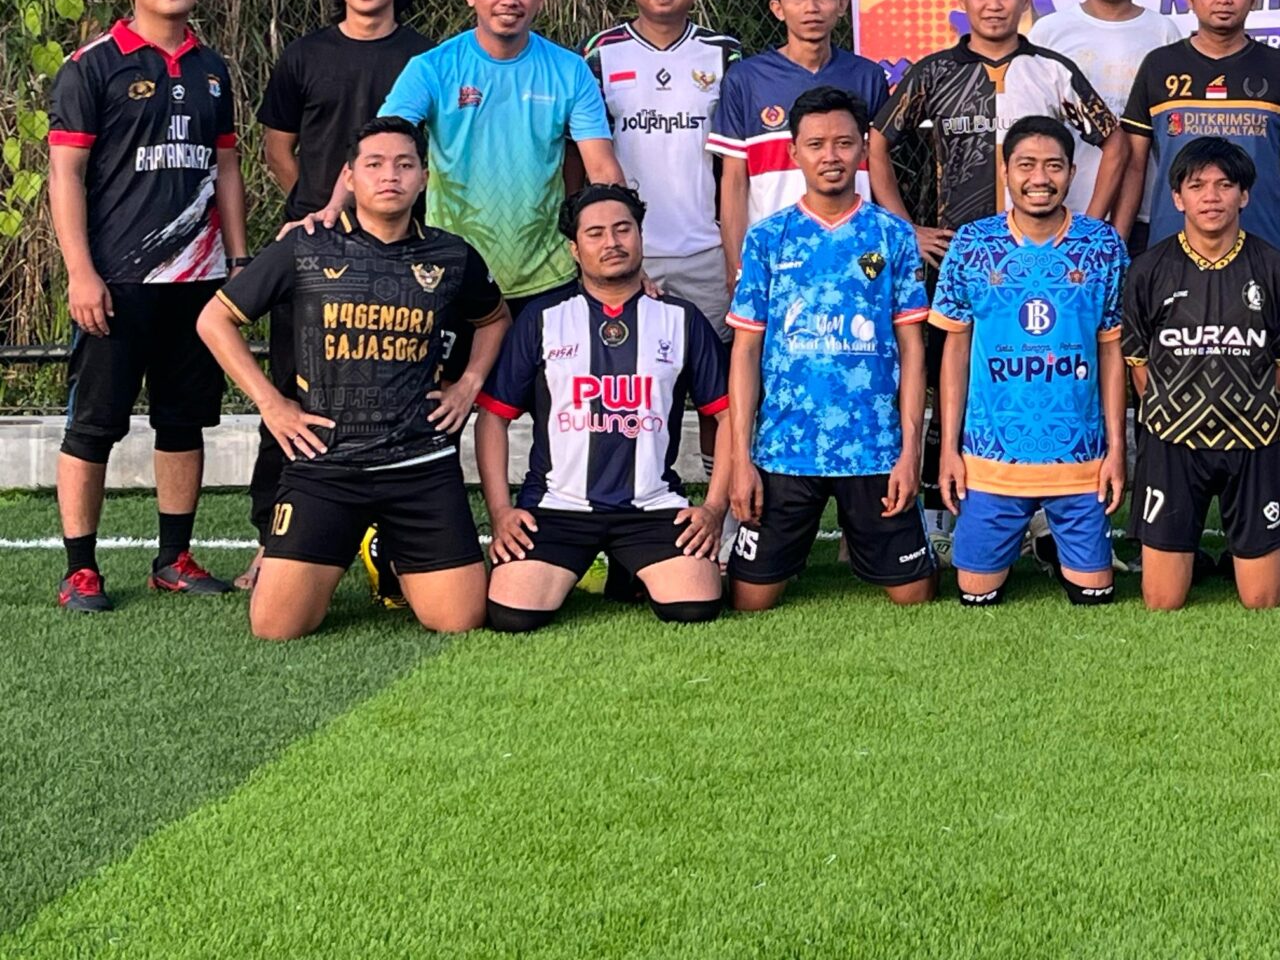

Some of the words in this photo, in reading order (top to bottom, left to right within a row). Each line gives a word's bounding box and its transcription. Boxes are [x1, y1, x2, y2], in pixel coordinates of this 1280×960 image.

[1165, 74, 1193, 98] 92
[1184, 112, 1269, 126] DITKRIMSUS
[1184, 124, 1220, 136] POLDA
[324, 333, 429, 362] GAJASORA
[1158, 325, 1267, 349] QUR'AN
[1173, 346, 1251, 357] GENERATION
[572, 375, 653, 411] PWI
[557, 411, 664, 438] Bulungan
[1143, 486, 1165, 524] 17
[271, 503, 293, 536] 10
